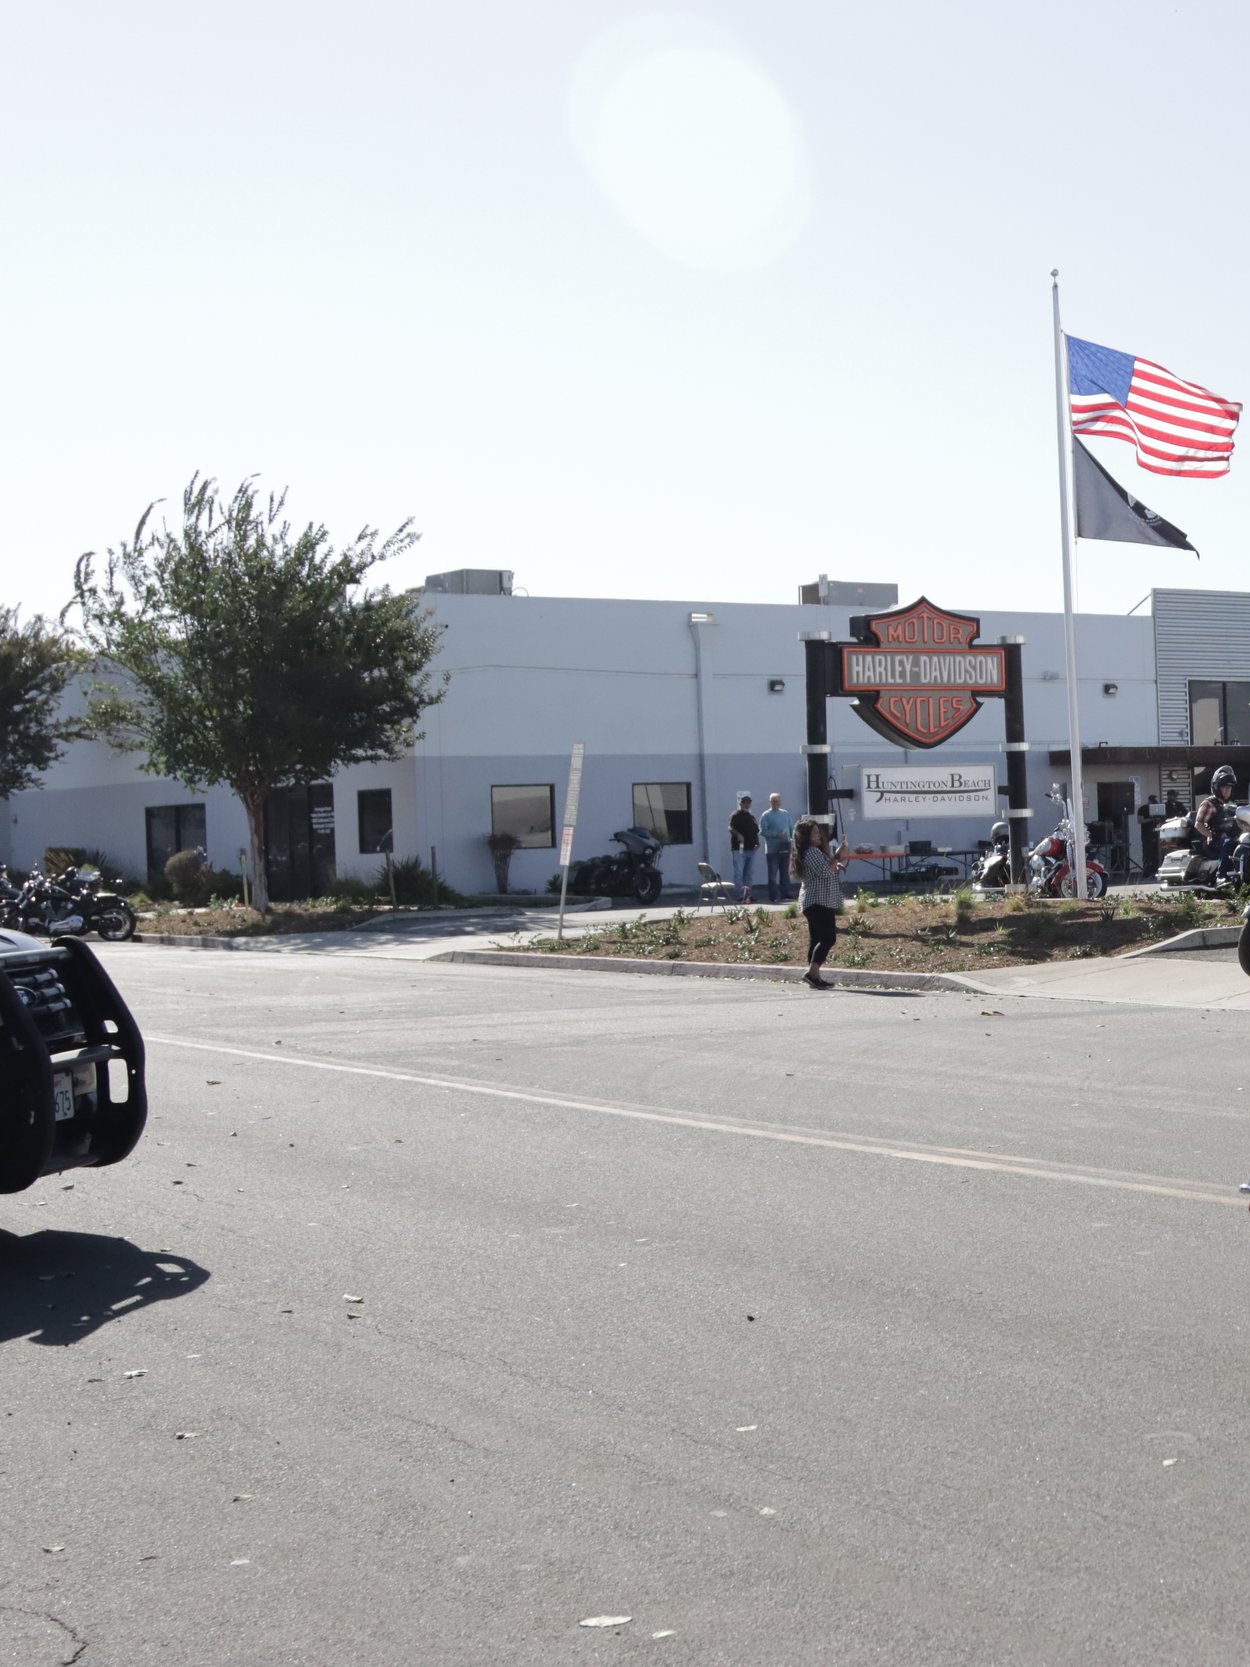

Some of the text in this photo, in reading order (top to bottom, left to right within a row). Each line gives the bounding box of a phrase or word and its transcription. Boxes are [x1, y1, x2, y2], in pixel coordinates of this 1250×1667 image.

[887, 612, 963, 645] MOTOR
[851, 655, 998, 684] HARLEY-DAVIDSON
[889, 696, 964, 734] CYCLES
[949, 772, 991, 789] BEACH
[884, 795, 988, 803] HARLEY-DAVIDSON
